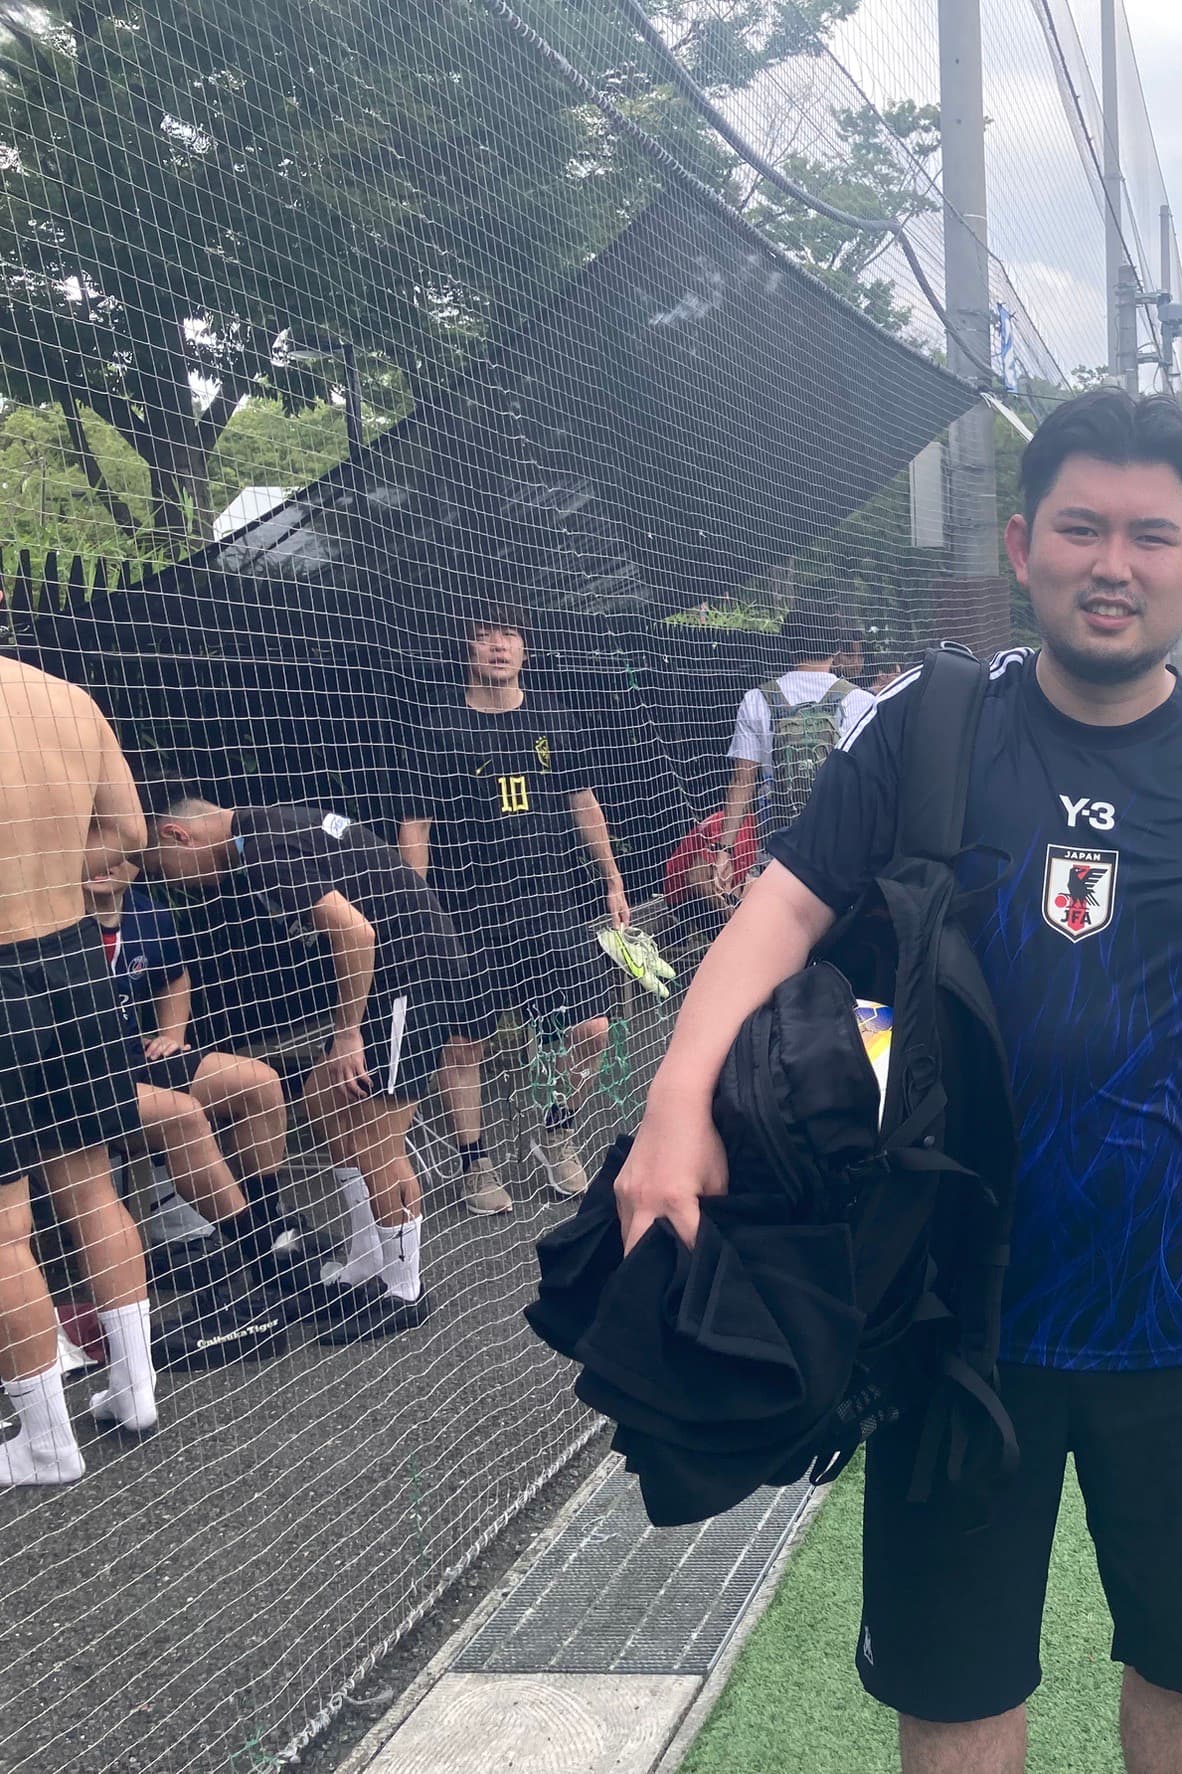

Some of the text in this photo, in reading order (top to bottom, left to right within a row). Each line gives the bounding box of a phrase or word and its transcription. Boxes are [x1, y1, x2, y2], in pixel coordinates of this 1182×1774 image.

[498, 776, 528, 812] 10
[1059, 794, 1116, 830] Y-3
[1064, 850, 1101, 861] JAPAN
[1060, 909, 1092, 926] JFA
